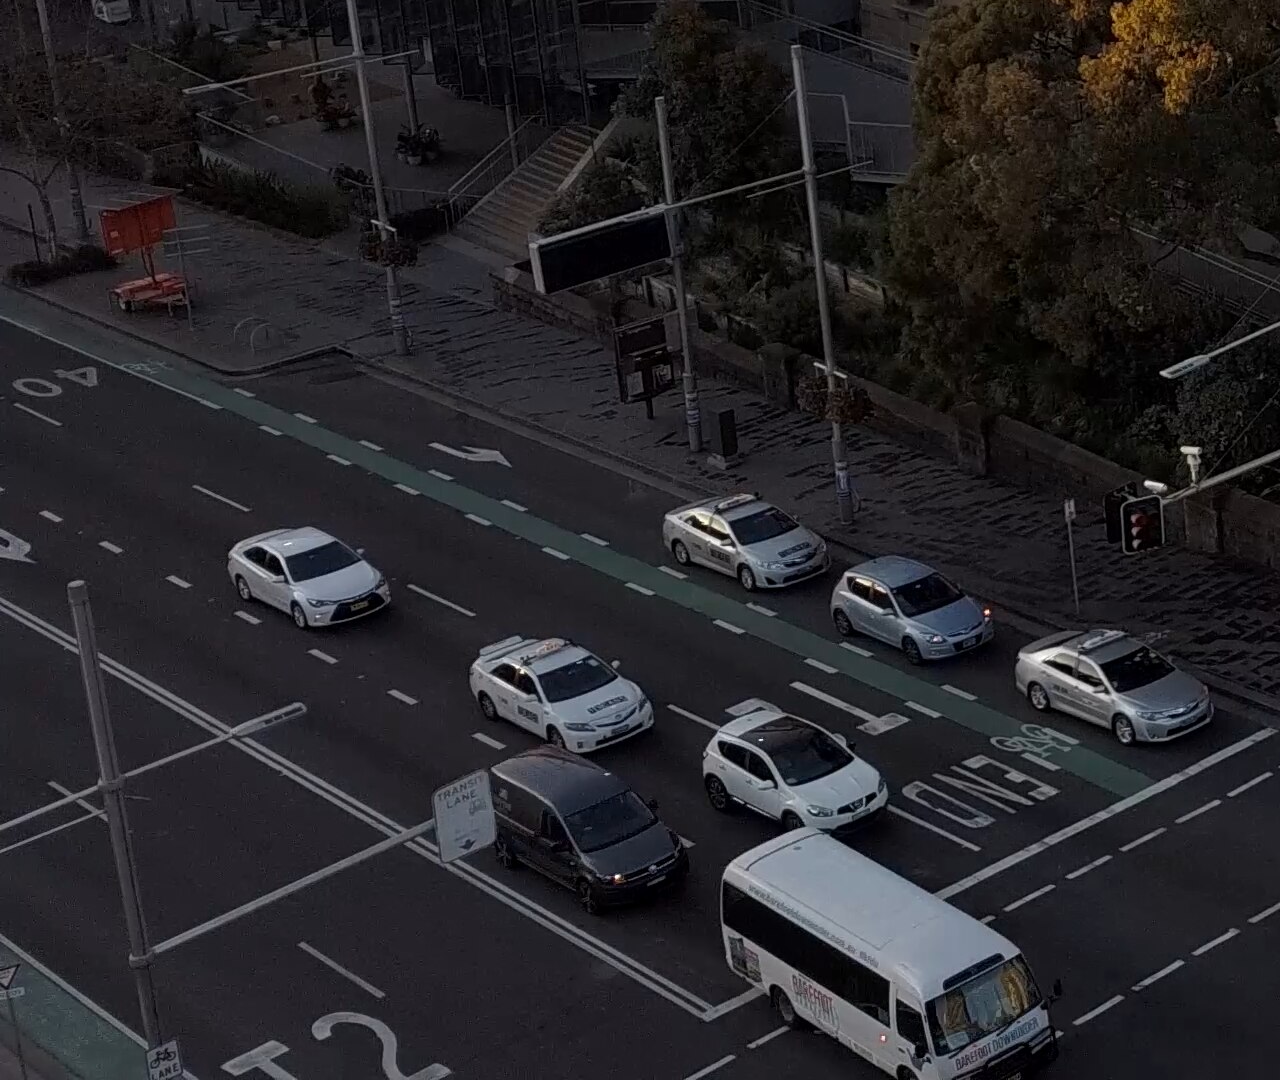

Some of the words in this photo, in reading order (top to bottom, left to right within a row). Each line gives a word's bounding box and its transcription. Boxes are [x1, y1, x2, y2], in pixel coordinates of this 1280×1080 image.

[437, 775, 483, 801] TRANSIT
[446, 789, 477, 809] LANE
[955, 1043, 992, 1071] BAREFOOT
[151, 1062, 179, 1080] LANE
